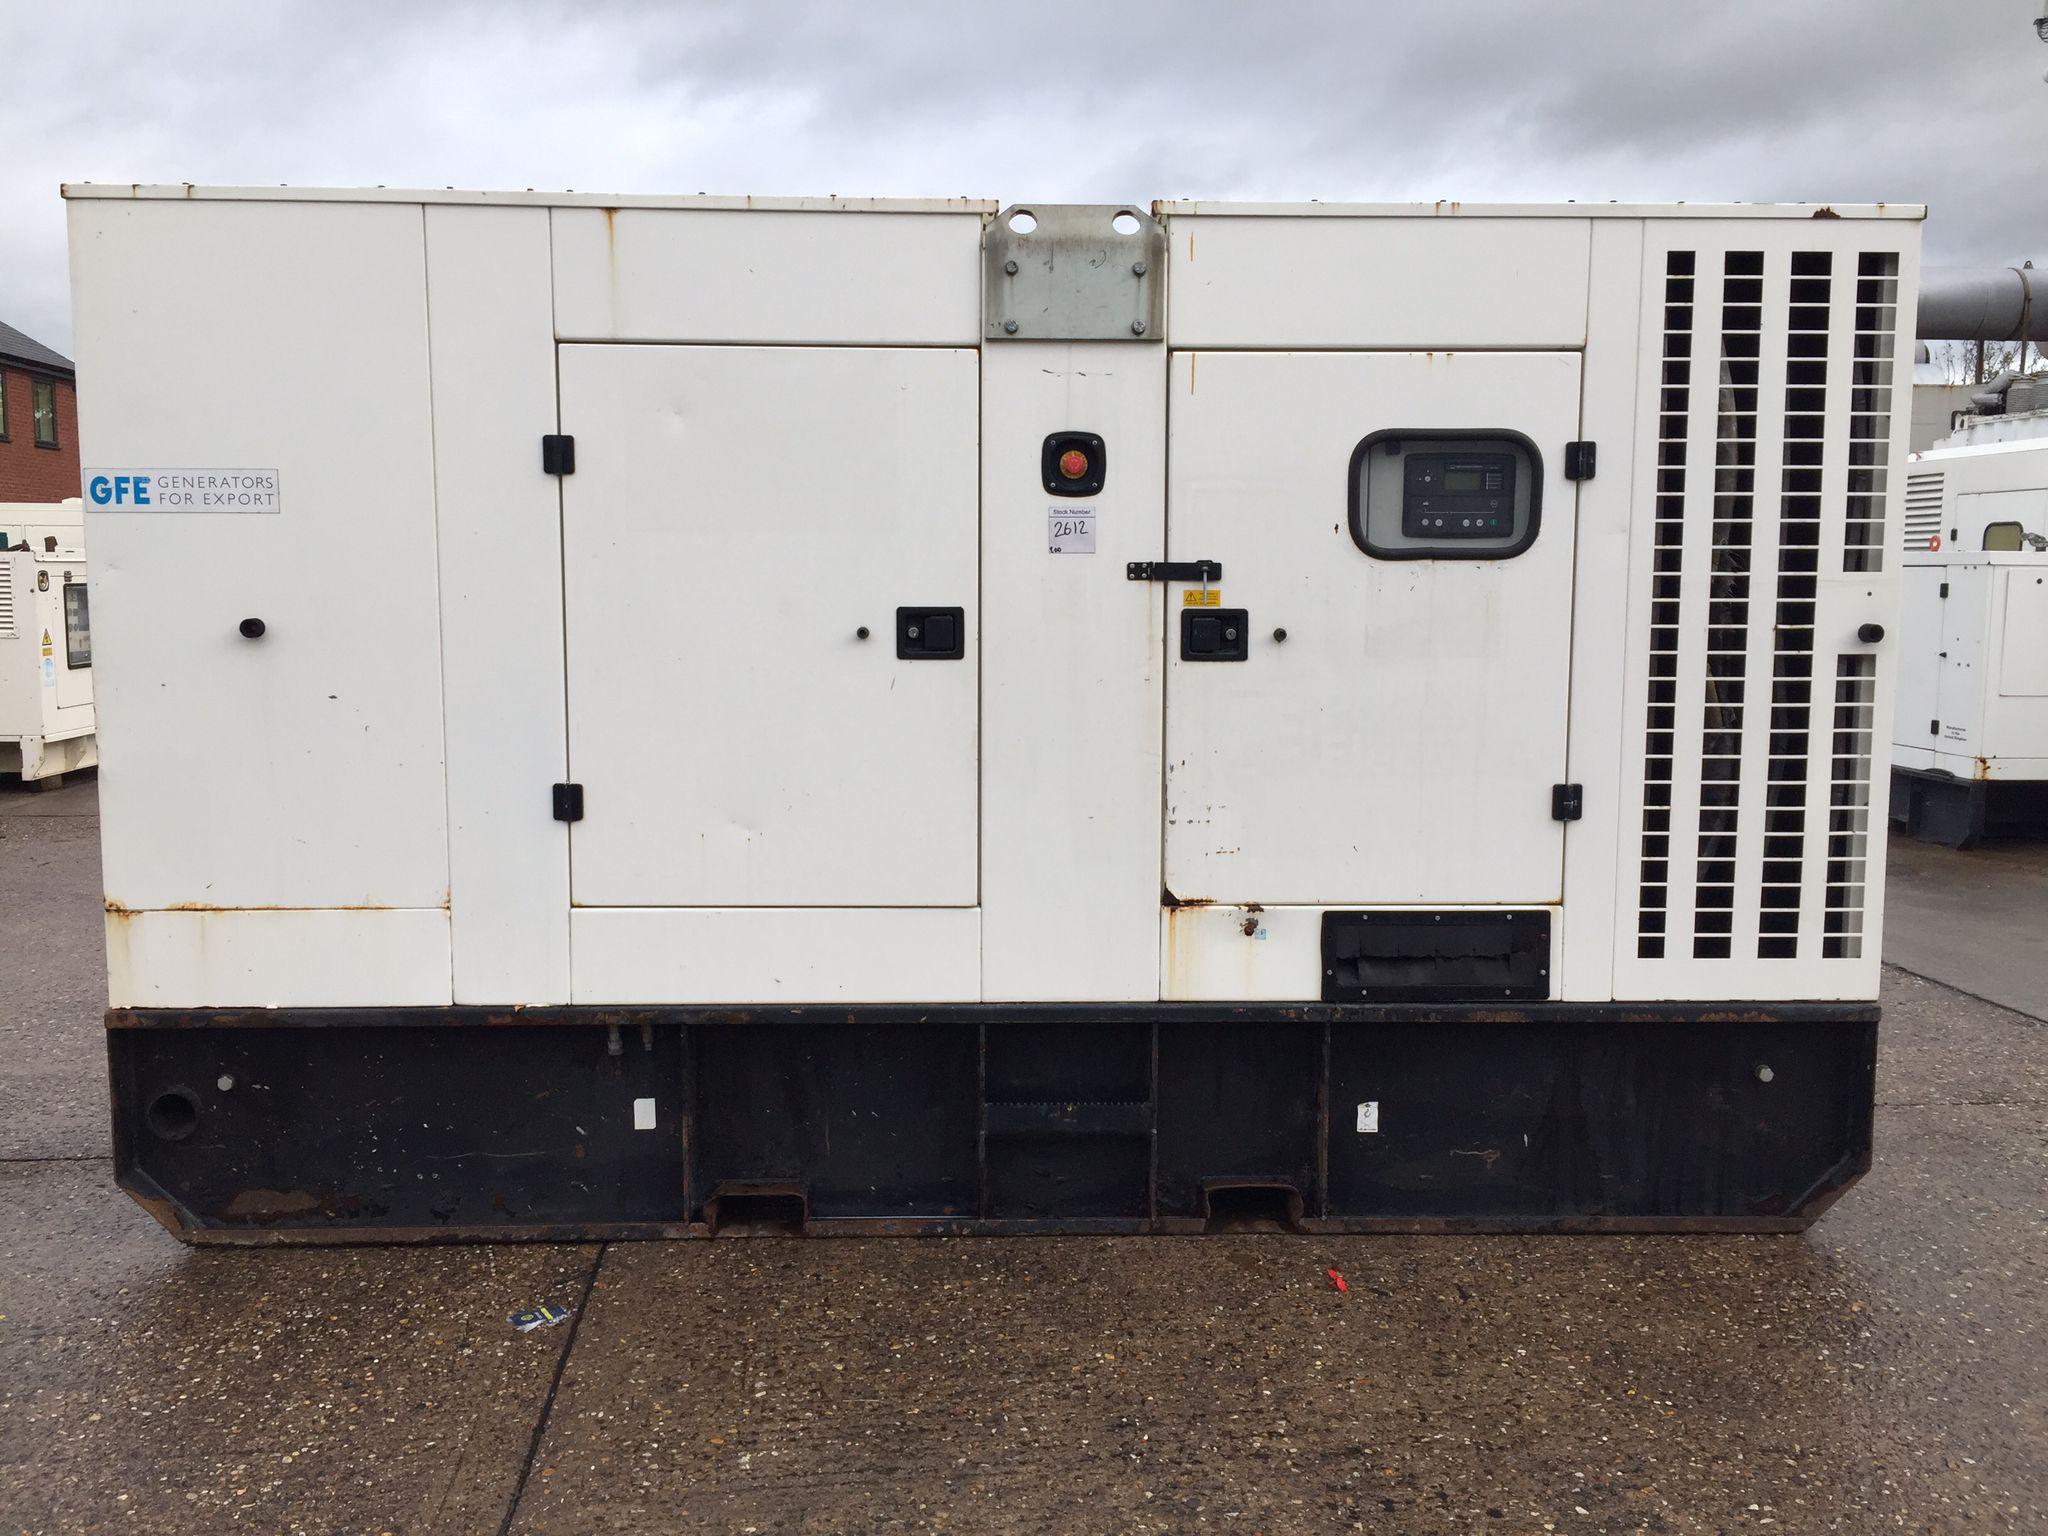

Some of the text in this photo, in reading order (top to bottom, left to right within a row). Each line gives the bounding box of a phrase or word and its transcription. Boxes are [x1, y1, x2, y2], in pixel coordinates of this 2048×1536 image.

[157, 476, 274, 489] GENERATORS
[90, 476, 151, 505] GFE
[159, 493, 275, 506] FOR EXPORT
[1054, 520, 1089, 538] 2612
